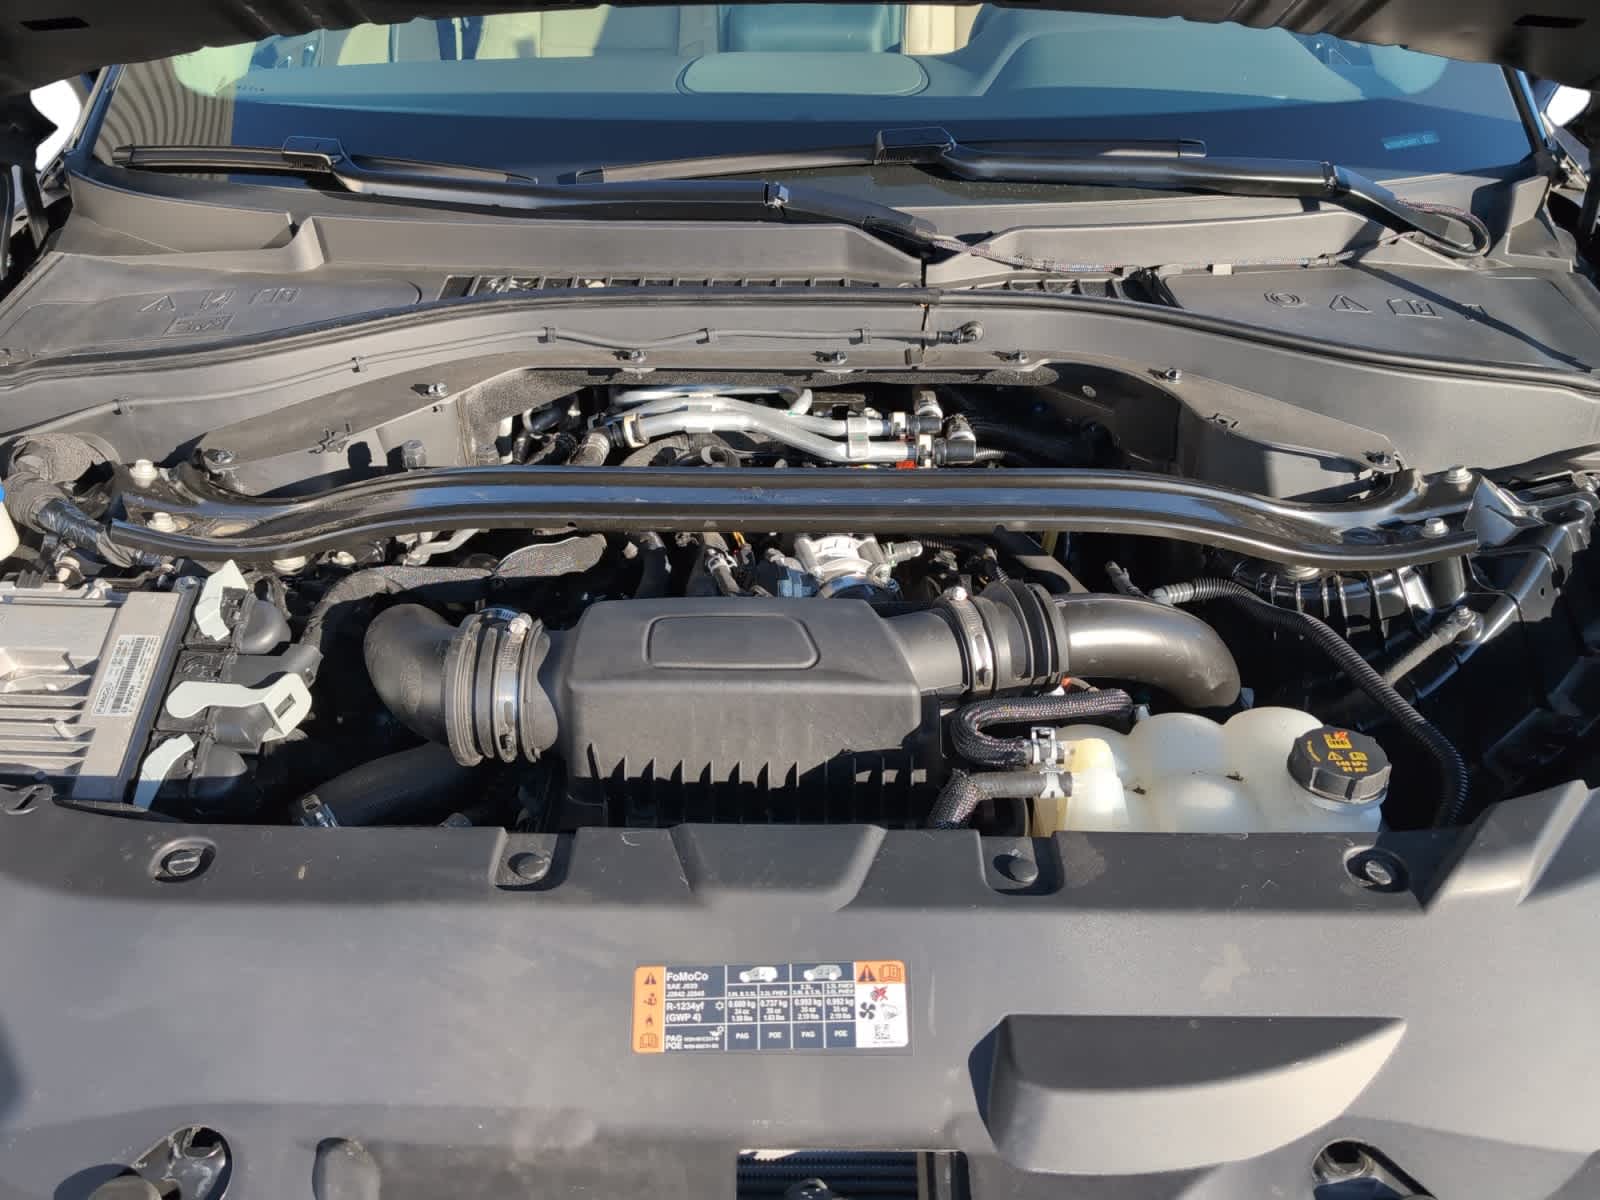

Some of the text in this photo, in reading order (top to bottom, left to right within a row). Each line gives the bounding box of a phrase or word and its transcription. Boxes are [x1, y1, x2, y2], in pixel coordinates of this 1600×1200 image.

[666, 971, 709, 982] FoMoCo
[666, 1001, 705, 1012] R-1234yf
[747, 1000, 756, 1009] kg
[778, 999, 788, 1009] kg
[813, 998, 822, 1008] kg
[845, 997, 854, 1007] kg
[666, 1013, 691, 1023] (GWP
